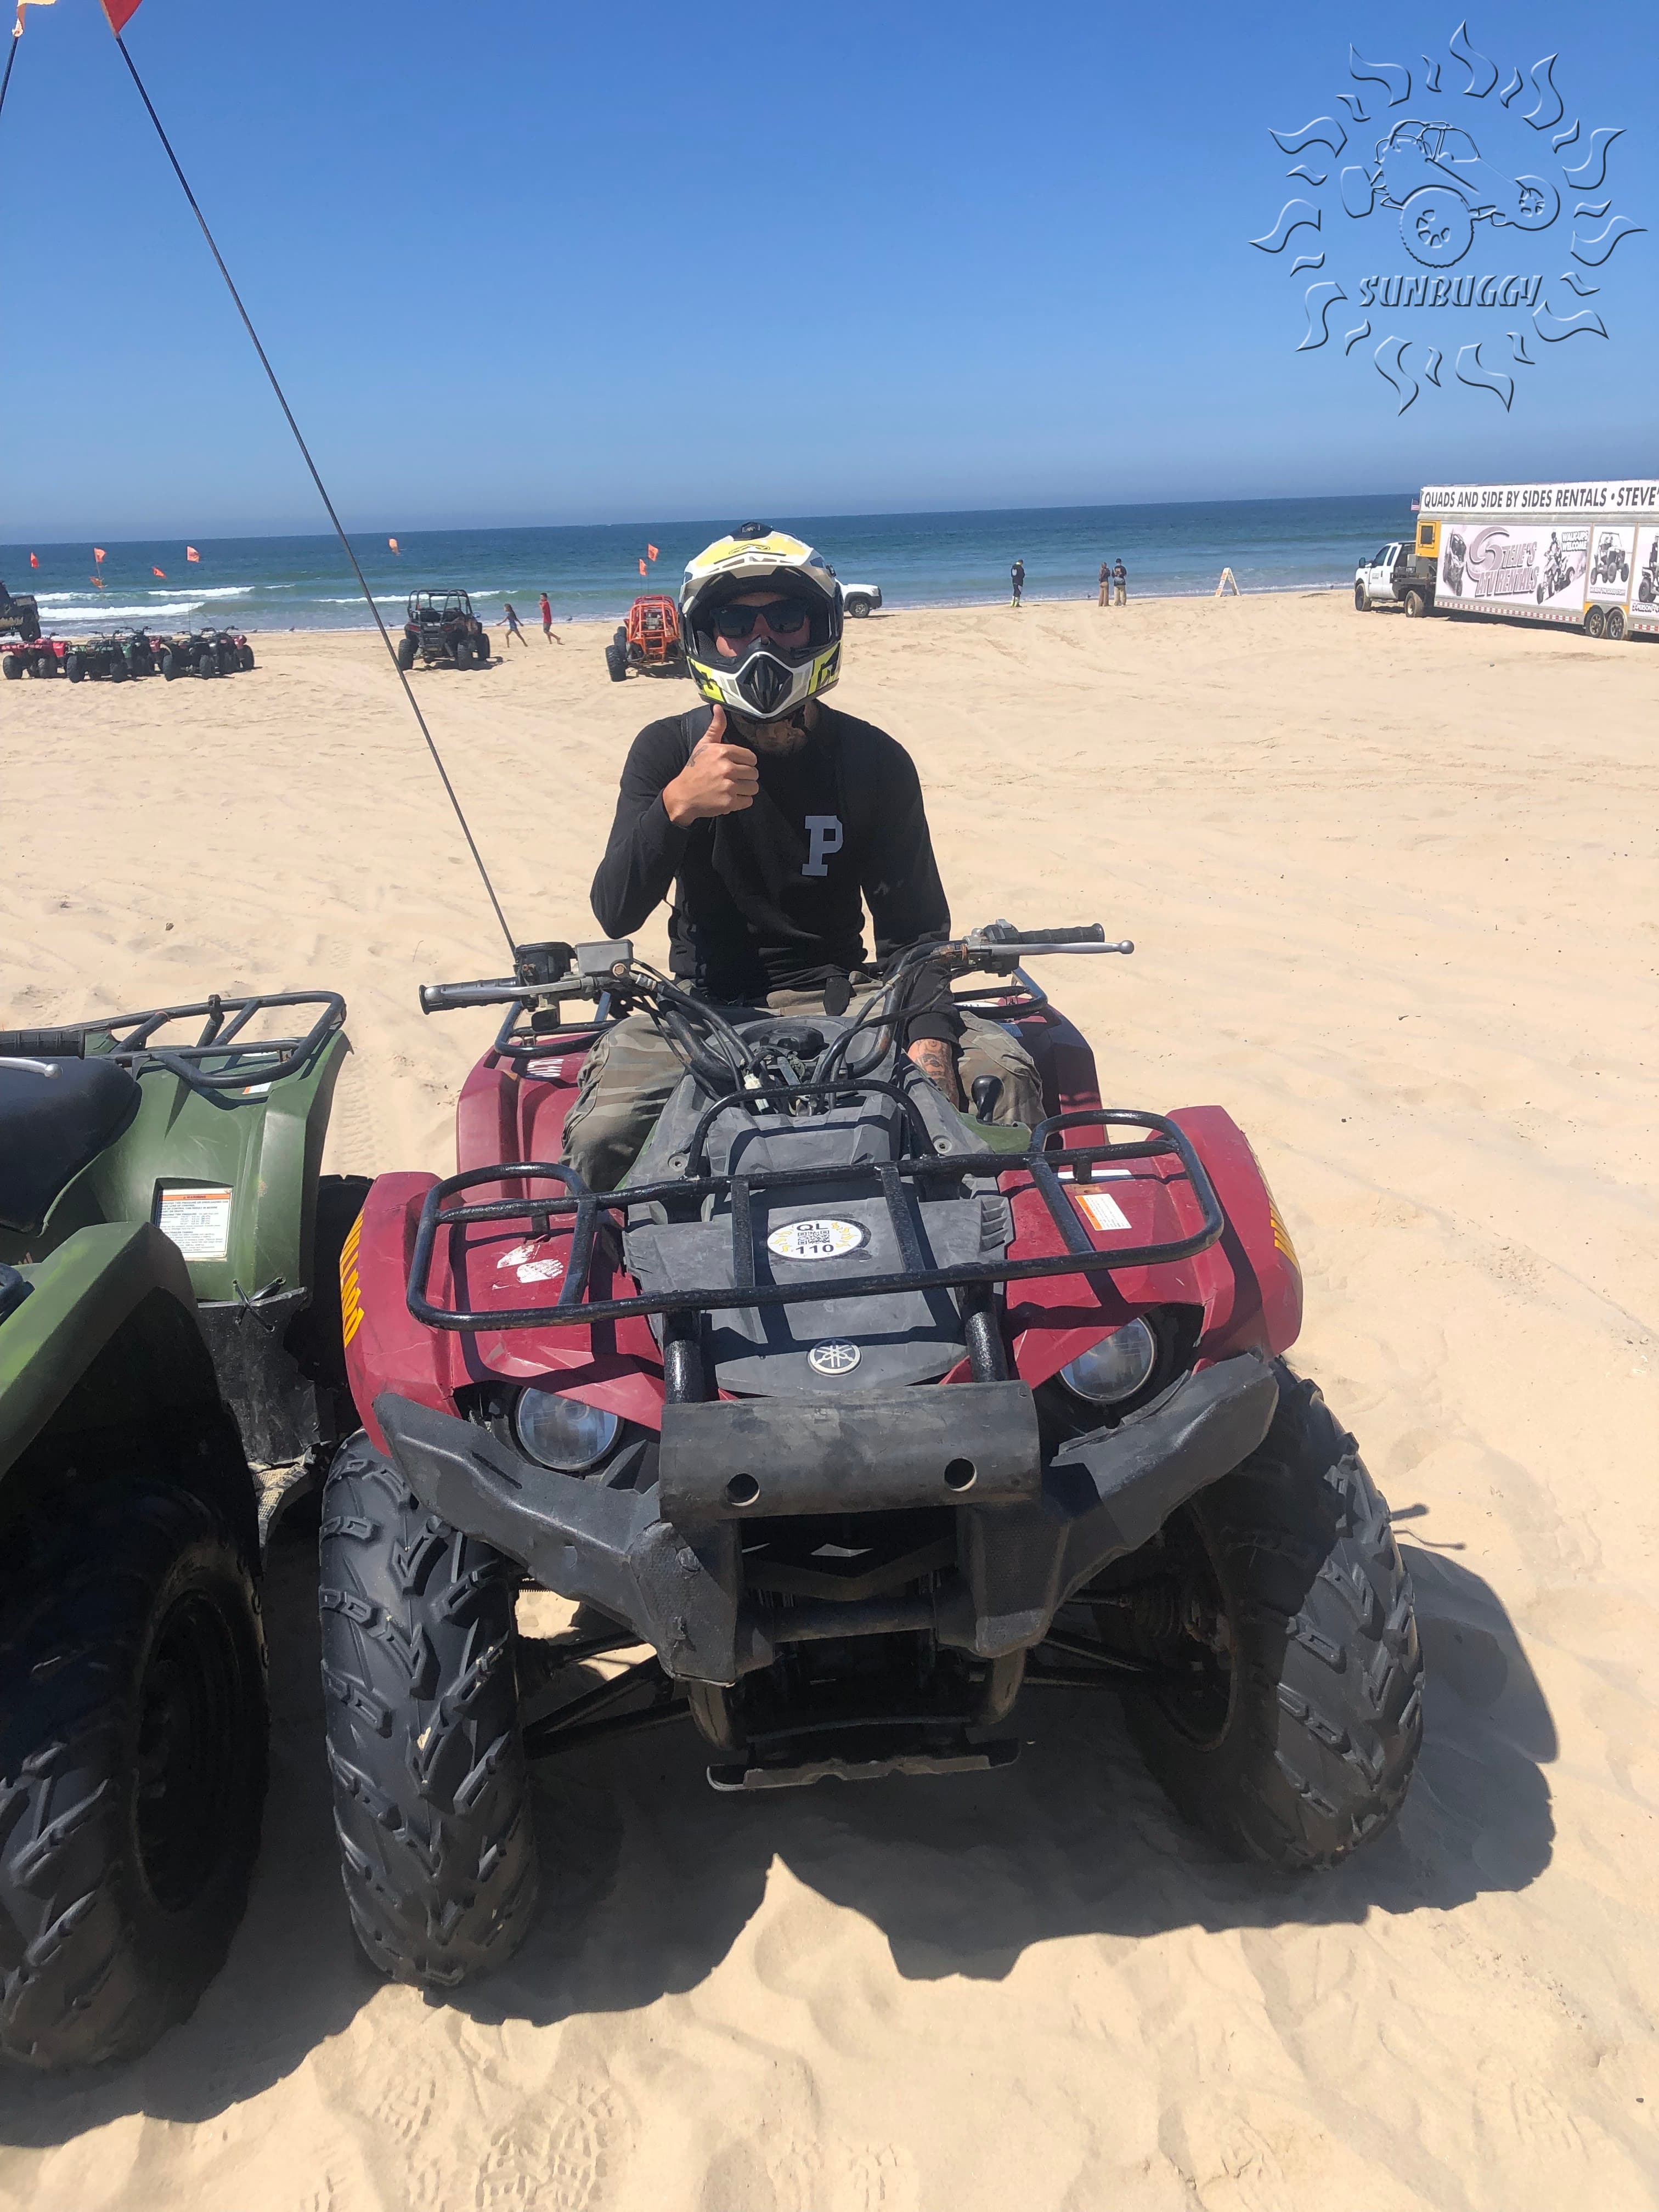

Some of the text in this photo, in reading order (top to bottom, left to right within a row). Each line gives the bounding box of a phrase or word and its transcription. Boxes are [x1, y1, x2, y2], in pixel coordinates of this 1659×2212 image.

[1424, 492, 1455, 508] QUADS
[1457, 492, 1479, 507] AND
[1481, 492, 1503, 507] SIDE
[1506, 491, 1520, 507] BY
[1521, 489, 1552, 507] SIDES
[1555, 488, 1607, 507] RENTALS
[1466, 526, 1537, 582] STEVE'S
[1562, 541, 1587, 551] WELCOME
[1475, 566, 1539, 598] ATV RENTALS
[802, 815, 843, 876] P
[795, 1244, 834, 1254] 110
